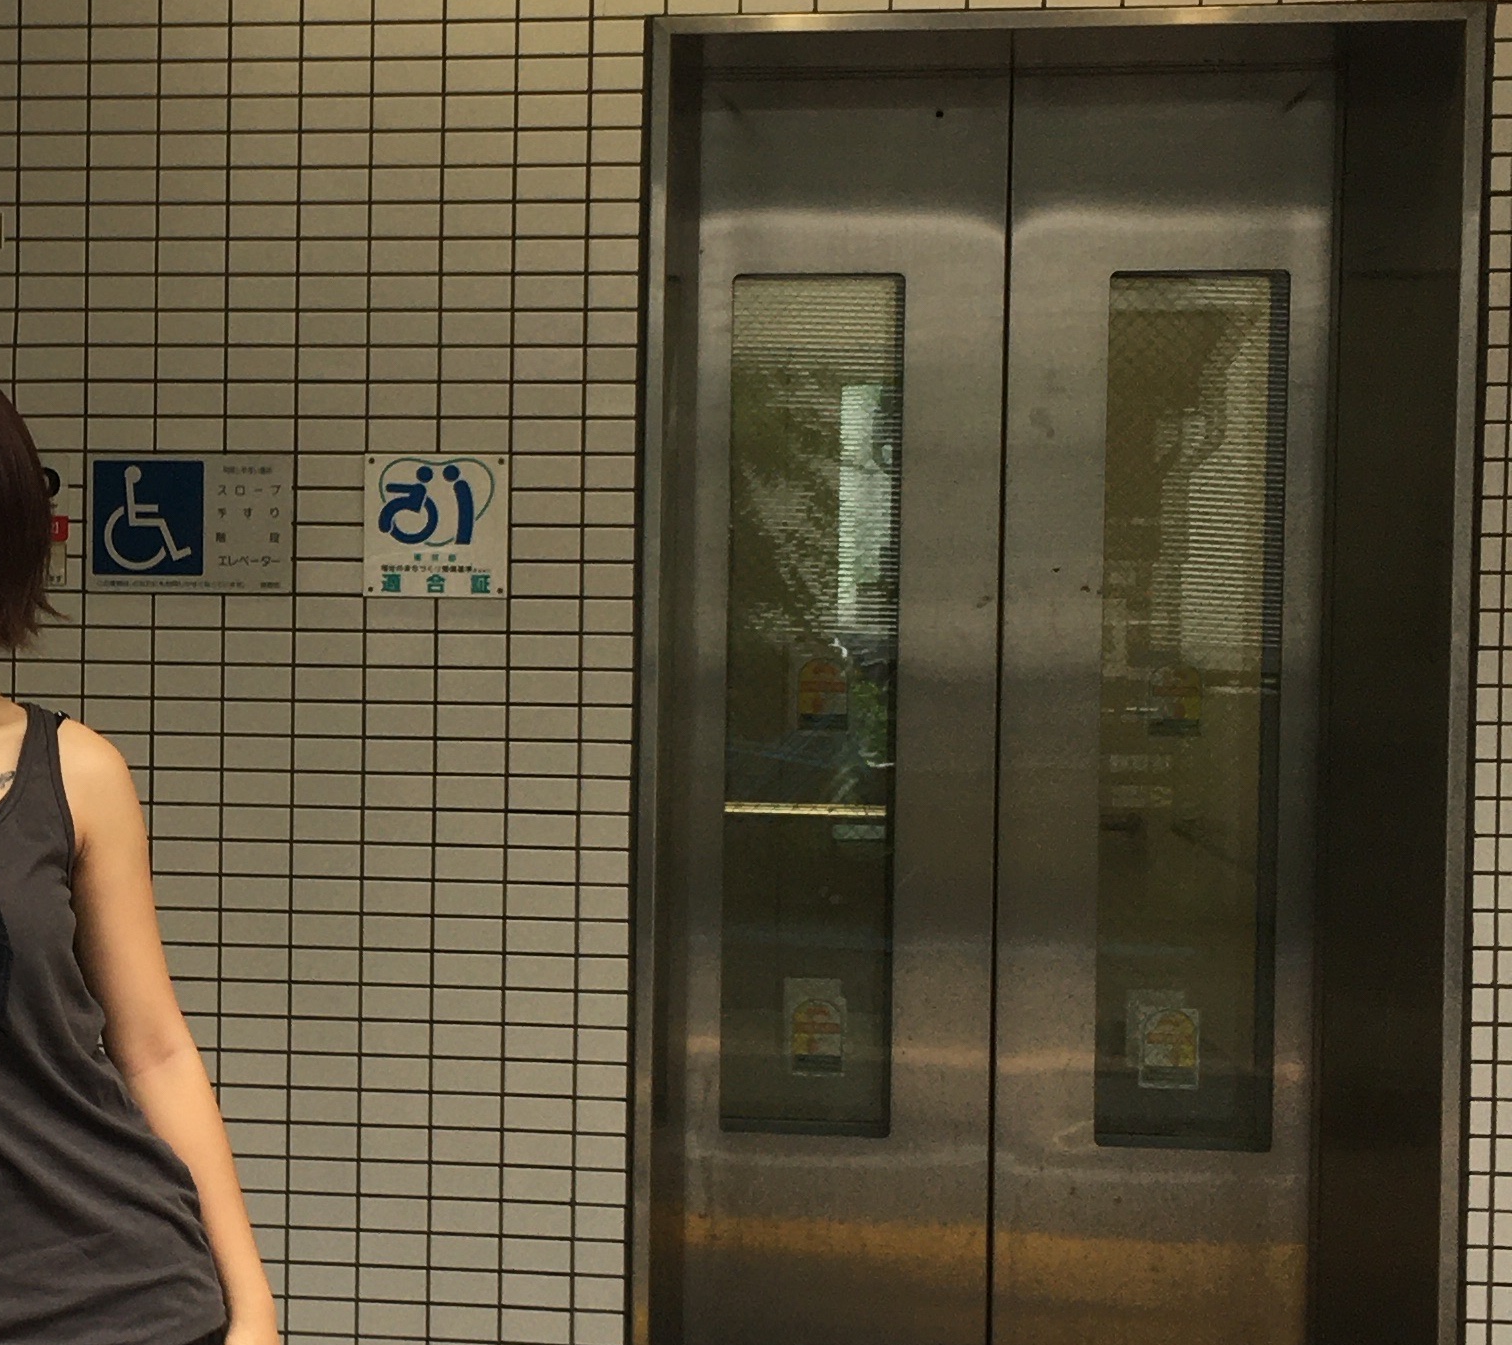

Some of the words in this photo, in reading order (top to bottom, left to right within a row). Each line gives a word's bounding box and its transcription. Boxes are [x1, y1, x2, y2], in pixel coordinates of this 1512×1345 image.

[217, 484, 281, 497] スロープ
[217, 507, 280, 520] 手すり
[216, 532, 280, 543] 階段
[218, 555, 281, 567] エレベーター
